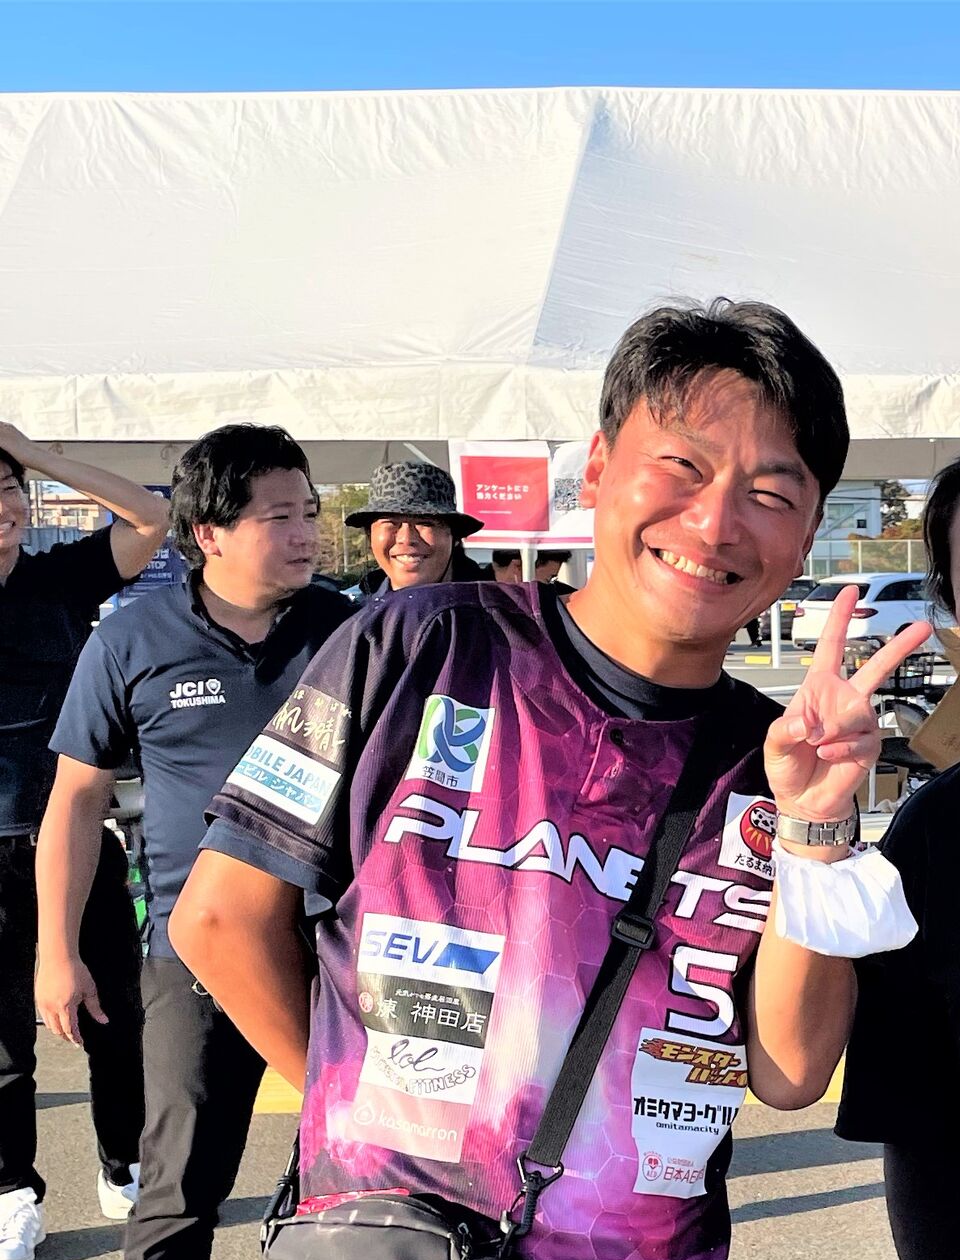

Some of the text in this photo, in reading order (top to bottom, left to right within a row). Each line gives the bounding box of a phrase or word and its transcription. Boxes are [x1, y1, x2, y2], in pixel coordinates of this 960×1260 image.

[170, 681, 204, 699] JCI
[171, 695, 226, 709] TOKUSHIMA
[284, 763, 333, 797] JAPAN
[423, 765, 460, 788] 笠間市
[361, 930, 440, 964] SEV
[669, 946, 739, 1037] 5
[410, 1001, 488, 1034] 神田店
[660, 1042, 741, 1069] モンスター
